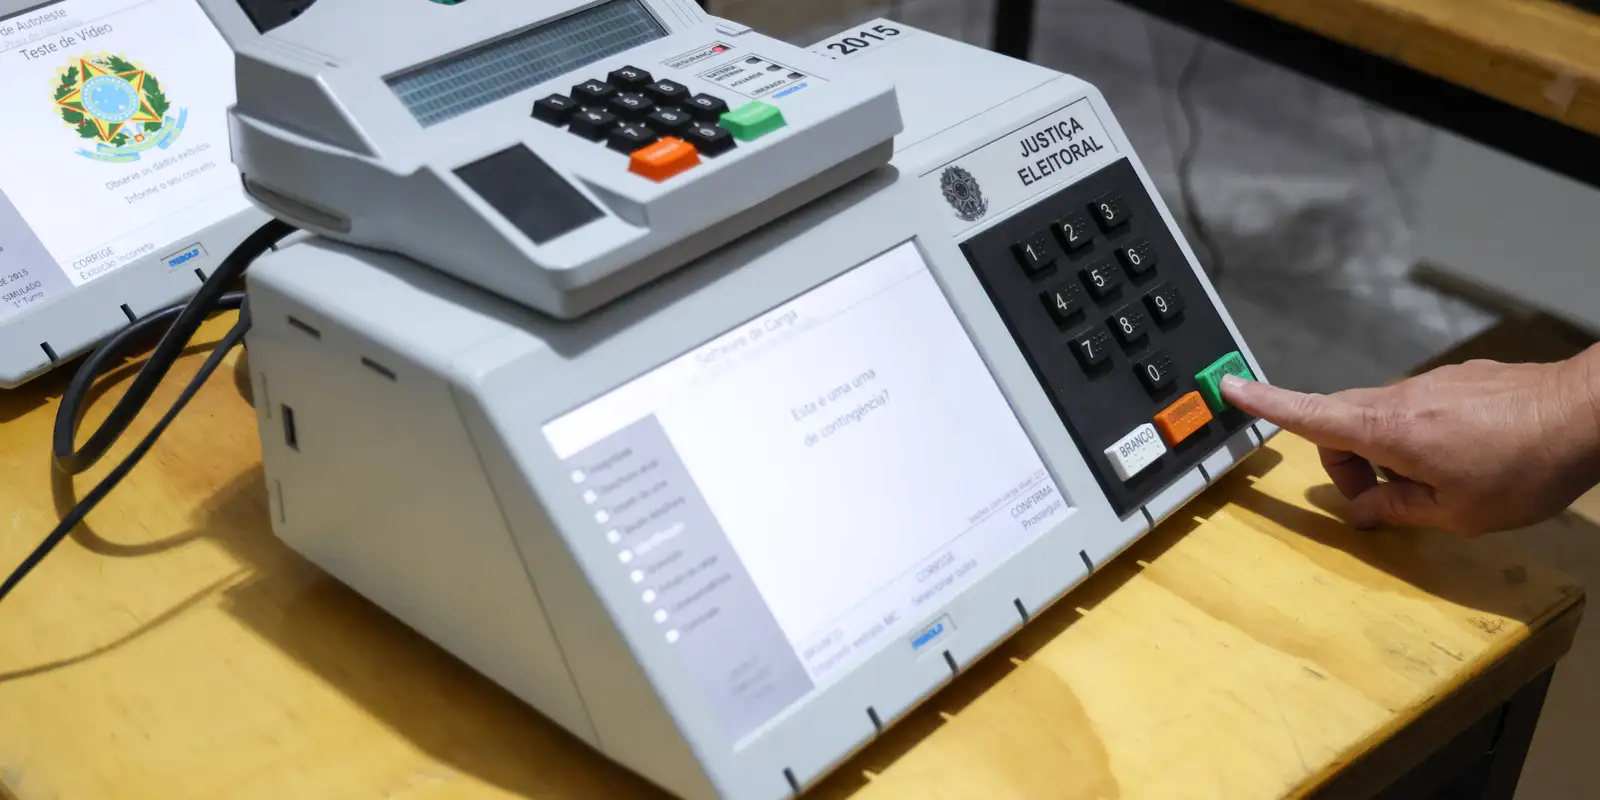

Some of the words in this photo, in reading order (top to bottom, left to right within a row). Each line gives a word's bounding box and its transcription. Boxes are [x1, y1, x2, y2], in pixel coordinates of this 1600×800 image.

[0, 26, 15, 37] de
[16, 8, 67, 31] Autoteste
[19, 42, 58, 61] Teste
[60, 36, 76, 48] de
[75, 23, 113, 42] Vídeo
[826, 25, 901, 56] 2015
[621, 70, 636, 78] 3
[587, 84, 602, 92] 2
[659, 84, 674, 92] 6
[550, 98, 564, 106] 1
[623, 98, 638, 106] 5
[588, 112, 601, 121] 4
[625, 128, 639, 137] 7
[699, 128, 715, 137] 0
[1020, 116, 1084, 158] JUSTIÇA
[1017, 135, 1103, 187] ELEITORAL
[105, 171, 141, 191] Observe
[153, 156, 178, 170] dados
[124, 185, 160, 205] Informe
[1100, 203, 1114, 220] 3
[1064, 223, 1078, 242] 2
[72, 245, 116, 271] CORRIGE
[1025, 244, 1038, 262] 1
[1127, 248, 1140, 266] 6
[8, 268, 29, 282] 2015
[1091, 268, 1104, 288] 5
[2, 280, 42, 302] SIMULADO
[1055, 292, 1068, 311] 4
[1155, 295, 1168, 313] 9
[763, 309, 799, 333] Carga
[1119, 316, 1133, 335] 8
[1081, 339, 1094, 359] 7
[1147, 364, 1160, 382] 0
[790, 401, 817, 422] Esta
[828, 381, 852, 402] uma
[804, 432, 820, 448] de
[820, 388, 891, 440] contingência?
[1119, 427, 1154, 458] BRANCO
[1010, 484, 1054, 519] CONFIRMA
